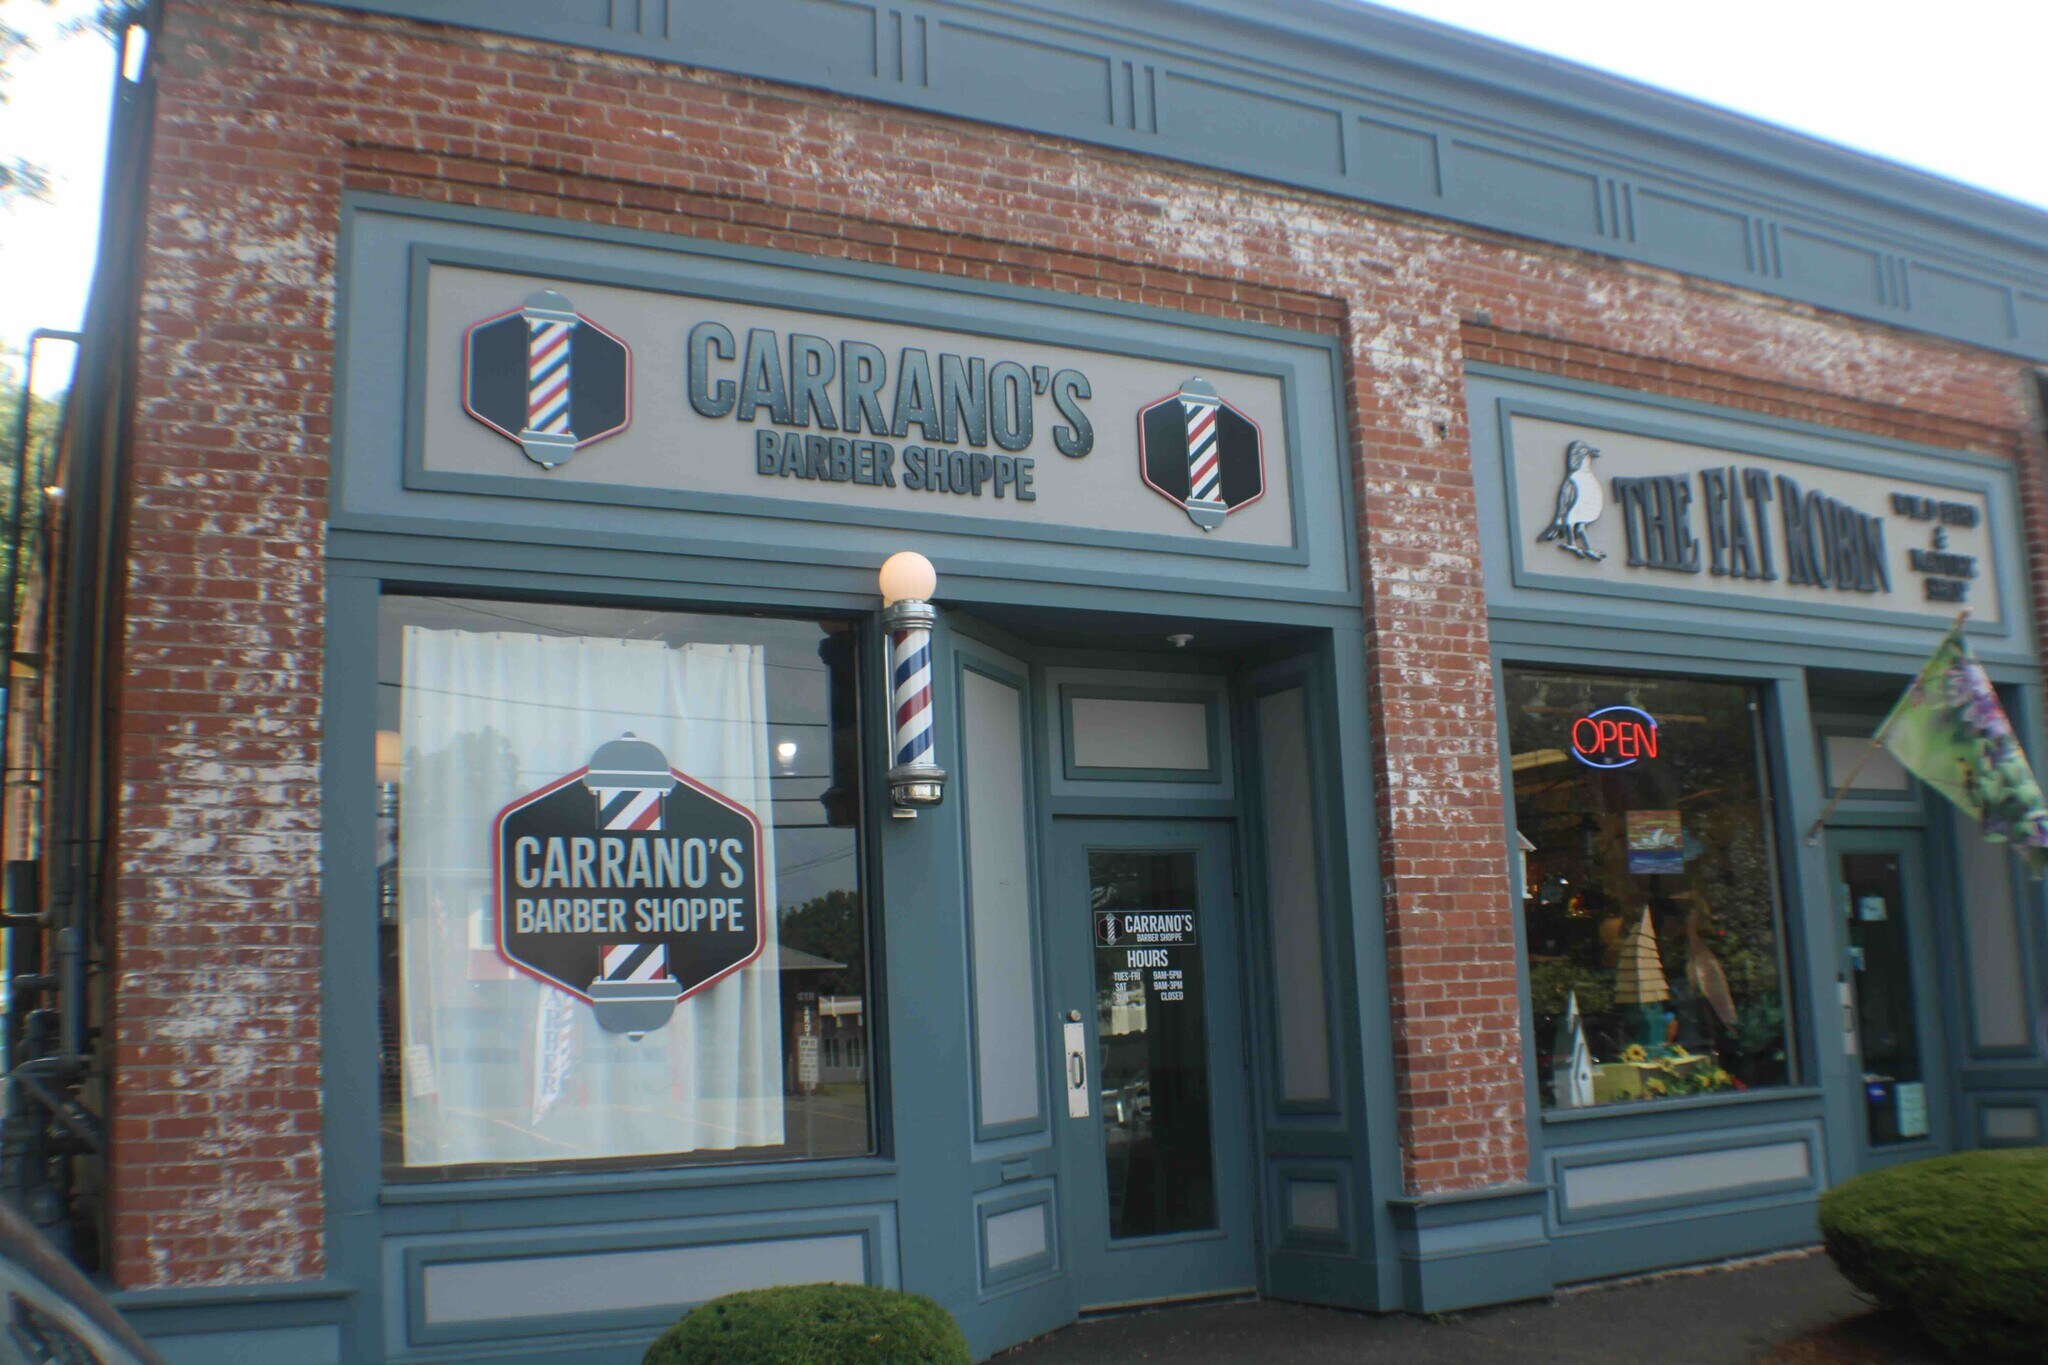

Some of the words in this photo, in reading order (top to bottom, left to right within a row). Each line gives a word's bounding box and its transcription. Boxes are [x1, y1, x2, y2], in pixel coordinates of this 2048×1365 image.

[688, 321, 1094, 458] CARRANO'S
[757, 429, 896, 488] BARBER
[903, 445, 1036, 501] SHOPPE
[1612, 472, 1701, 573] THE
[1700, 465, 1779, 580] FAT
[1776, 474, 1892, 593] ROBIN
[1572, 717, 1658, 758] OPEN
[514, 836, 744, 889] CARRANO'S
[516, 898, 627, 933] BARBER
[634, 898, 744, 932] SHOPPE
[1125, 915, 1193, 933] CARRANO'S
[1136, 933, 1159, 942] BARBER
[1160, 933, 1182, 942] SHOPPE
[1127, 950, 1168, 968] HOURS
[1115, 982, 1127, 992] SAT
[1153, 981, 1183, 991] 9AM-3PM
[1153, 970, 1182, 980] 9AM-5PM
[1160, 991, 1184, 1001] CLOSED
